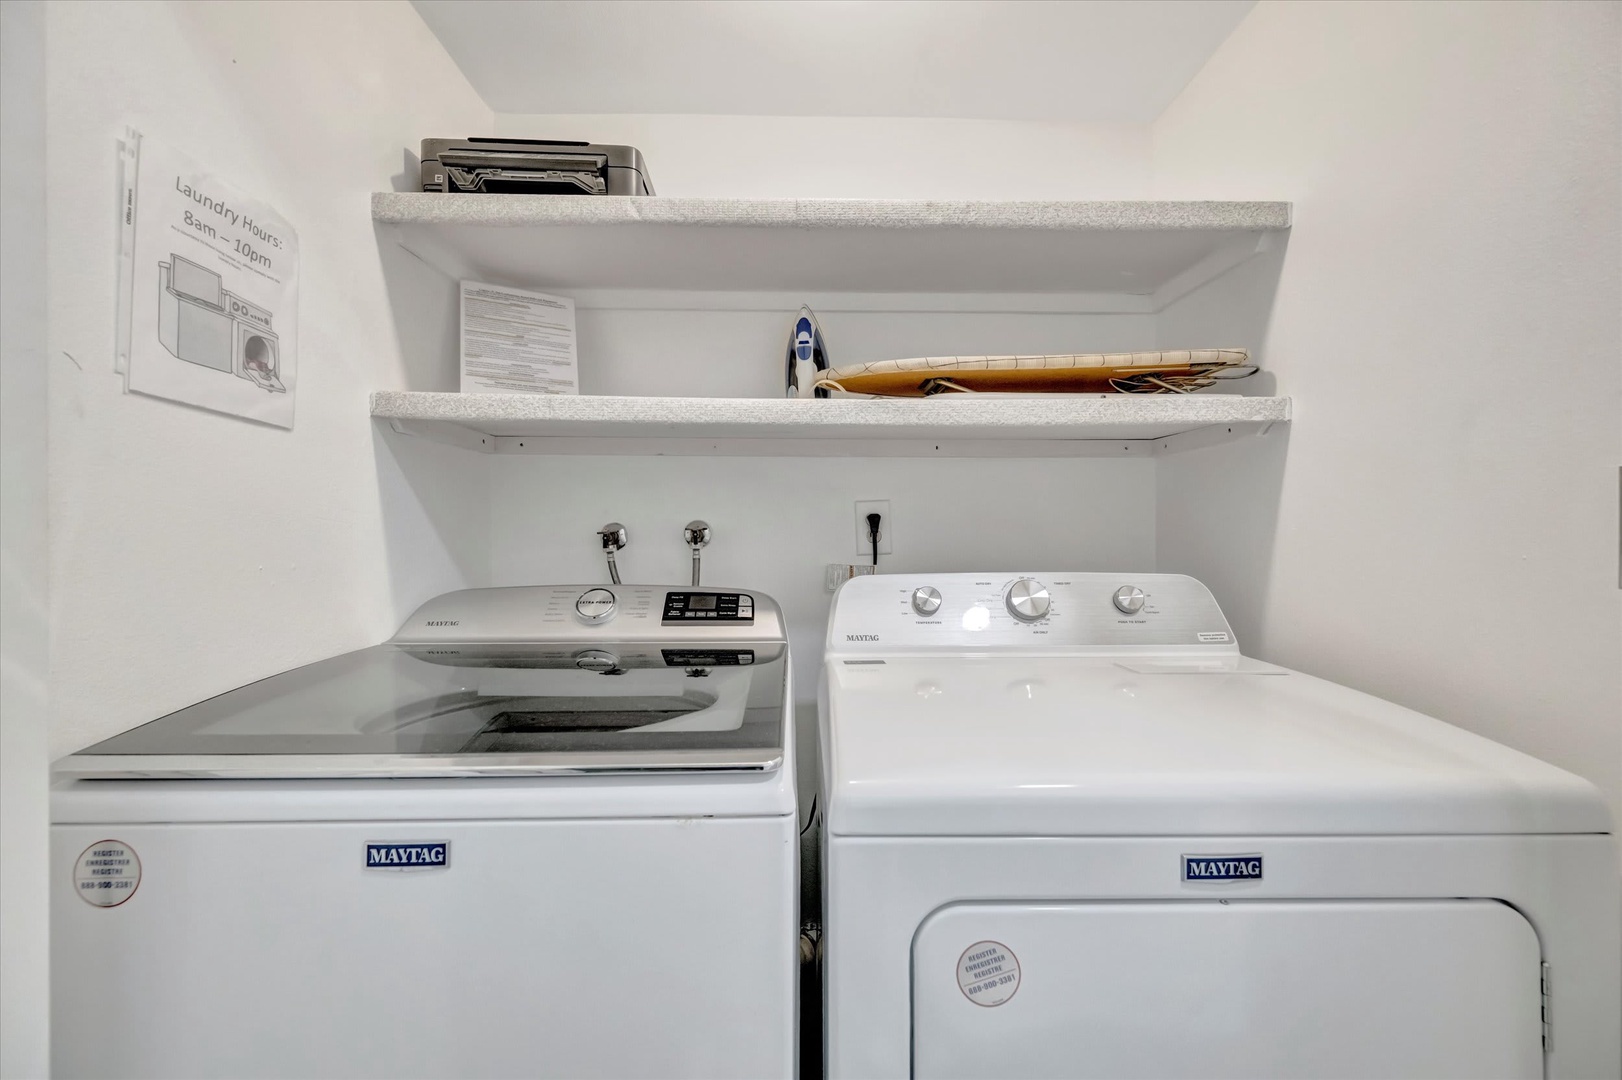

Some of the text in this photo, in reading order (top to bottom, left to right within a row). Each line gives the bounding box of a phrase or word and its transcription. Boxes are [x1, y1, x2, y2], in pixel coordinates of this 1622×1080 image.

[175, 176, 239, 225] Laundry
[242, 216, 283, 250] Hours:
[183, 210, 216, 240] 8am
[233, 239, 272, 268] 10pm
[369, 847, 444, 864] MAYTAG
[1189, 861, 1260, 876] MAYTAG
[965, 954, 1006, 973] ENREGISTRER
[968, 948, 997, 962] REGISTER
[973, 964, 1002, 979] REGISTRE
[968, 973, 1016, 995] 888-900-3381
